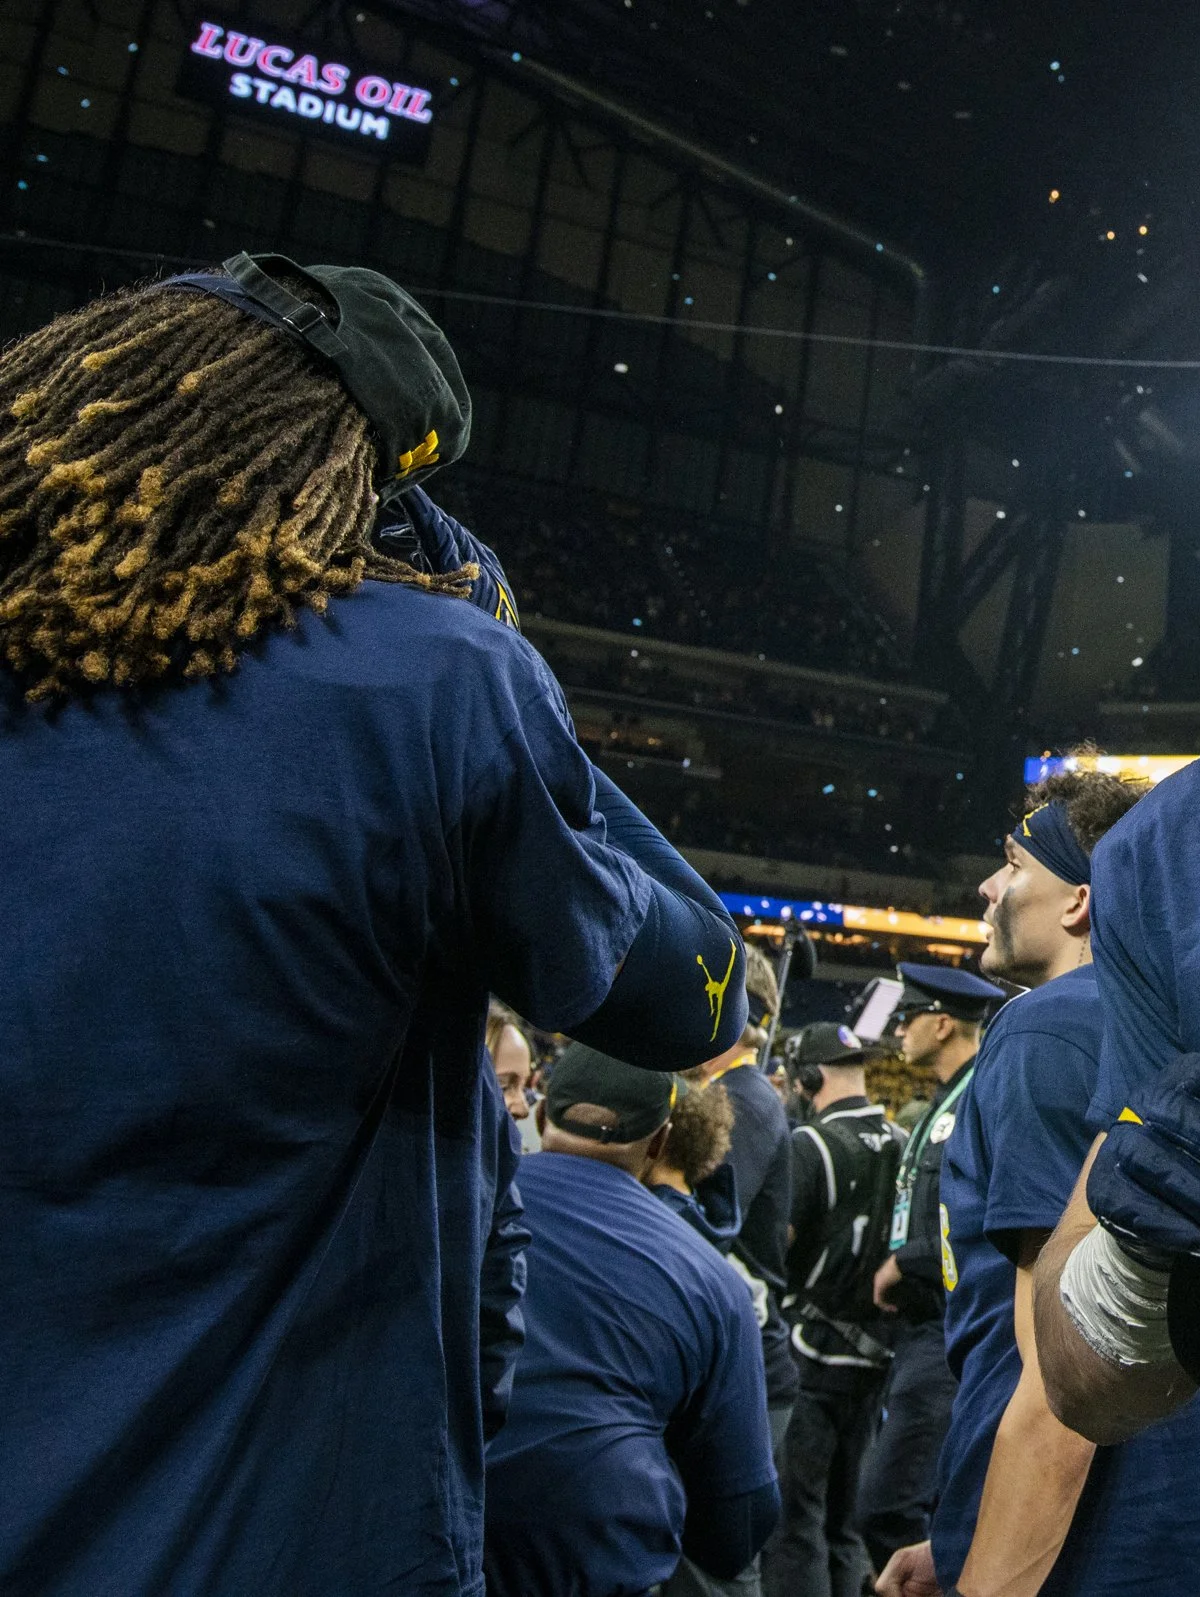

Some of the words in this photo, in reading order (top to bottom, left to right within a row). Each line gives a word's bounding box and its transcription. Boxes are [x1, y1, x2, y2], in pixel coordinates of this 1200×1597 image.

[191, 22, 350, 94] LUCAS
[355, 75, 433, 124] OIL
[229, 72, 390, 140] STADIUM
